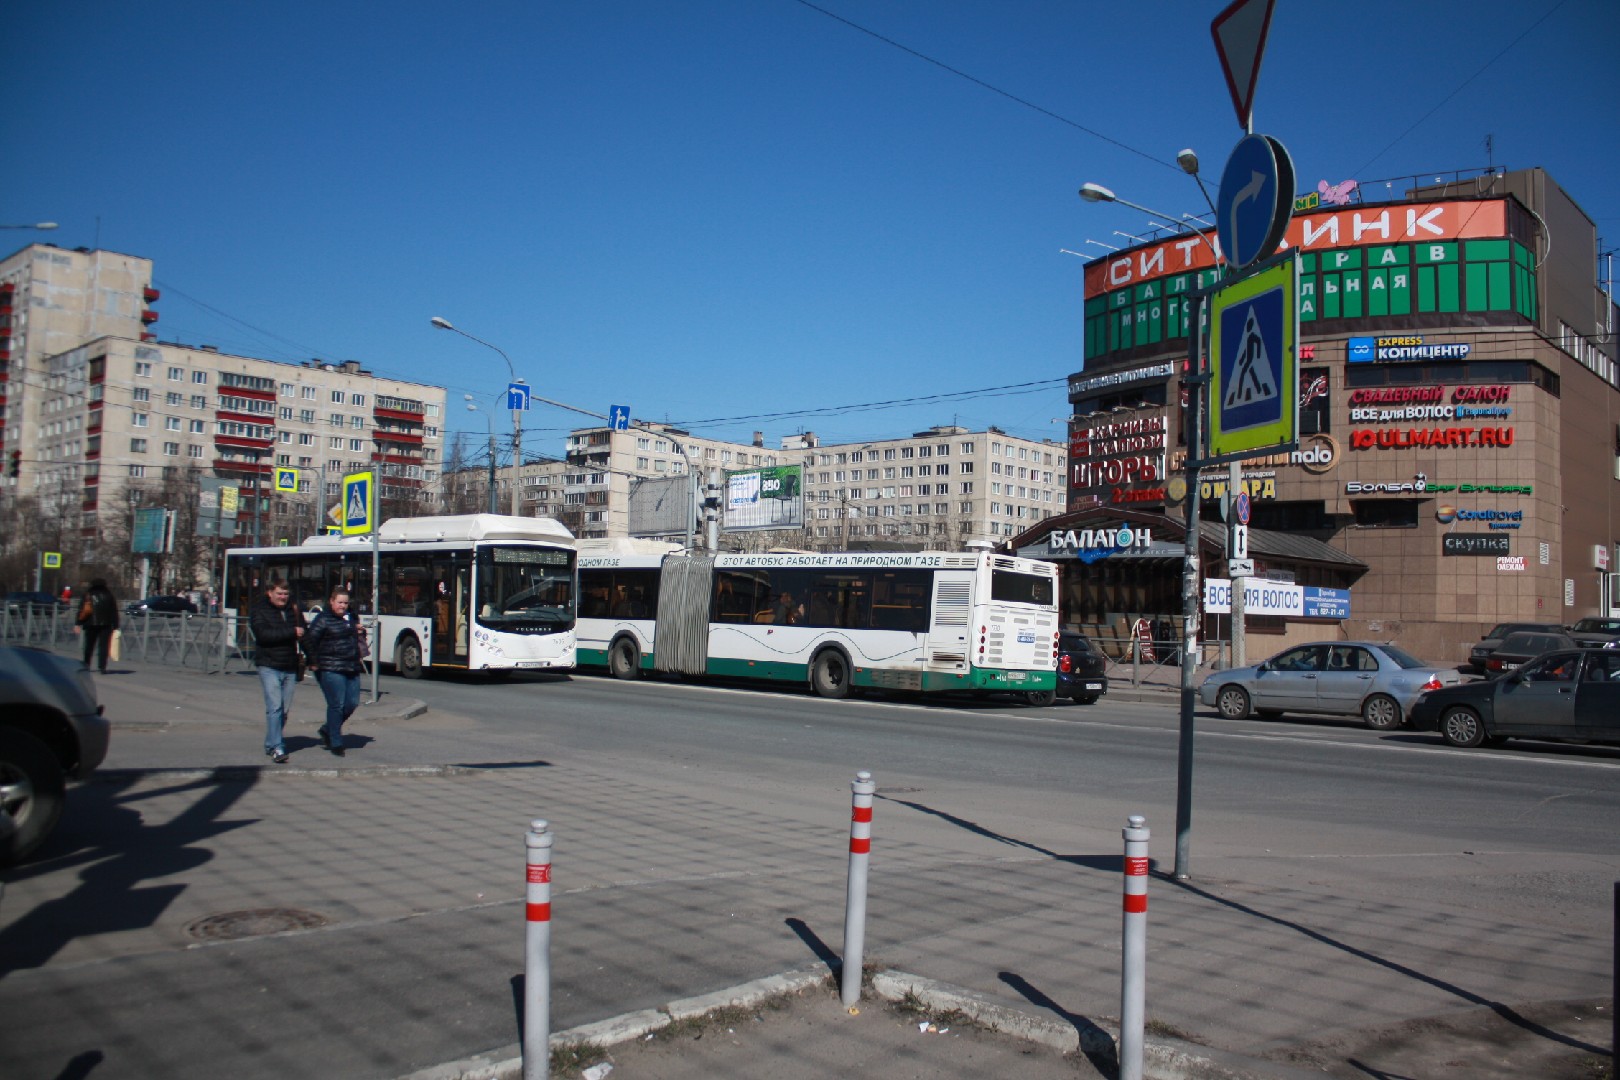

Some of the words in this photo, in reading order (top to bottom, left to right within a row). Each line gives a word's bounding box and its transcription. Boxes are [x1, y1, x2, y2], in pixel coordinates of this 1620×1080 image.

[1110, 207, 1444, 286] СИТИНК
[1378, 336, 1423, 347] EXPRESS
[1378, 344, 1469, 359] КОПИЦЕНТР
[1351, 384, 1446, 403] СВАДЕБНЫЙ
[1454, 385, 1512, 400] САЛОН
[1352, 408, 1378, 420] ВСЕ
[1379, 409, 1405, 420] для
[1405, 405, 1454, 418] ВОЛОС
[1096, 416, 1168, 439] КАРНИЗЫ
[1379, 427, 1514, 447] ULMART.RU
[1096, 433, 1167, 456] ЖАЛЮЗИ
[1071, 454, 1166, 488] ШТОРЫ
[1200, 479, 1276, 499] ОМАРД
[1050, 528, 1152, 548] БАЛАТОН
[602, 558, 621, 567] ГАЗЕ
[722, 557, 744, 566] ЭТОТ
[744, 557, 784, 566] АВТОБУС
[786, 556, 833, 566] РАБОТАЕТ
[835, 556, 848, 565] НА
[850, 556, 912, 567] ПРИРОДНОМ
[914, 556, 941, 566] ГАЗЕ
[1496, 556, 1524, 564] РЕМОНТ
[1244, 588, 1260, 608] ЛЯ
[1262, 589, 1299, 609] ВОЛОС
